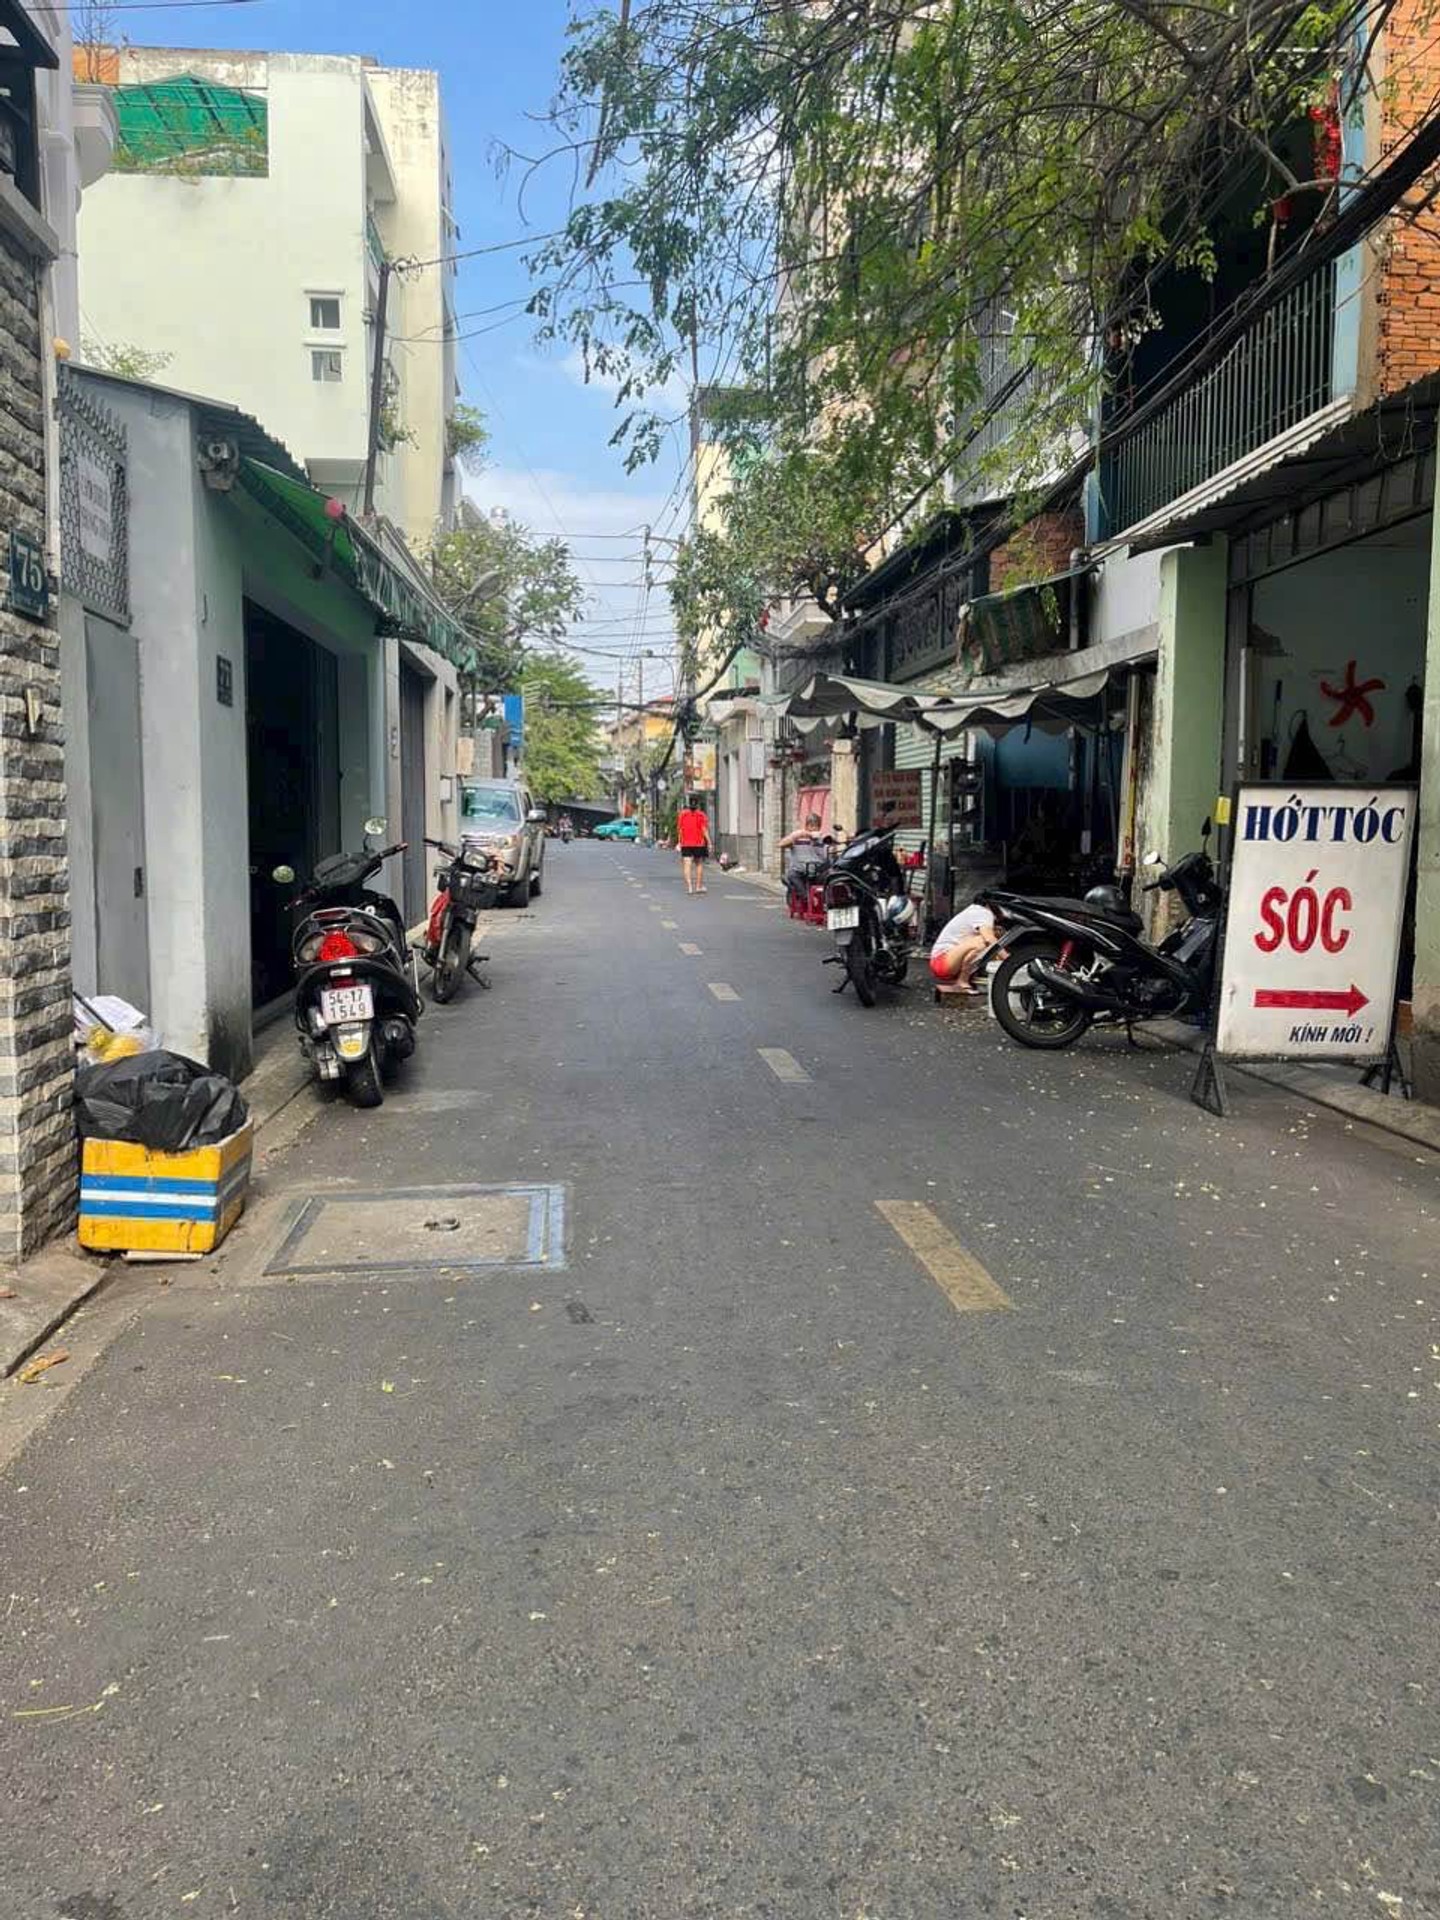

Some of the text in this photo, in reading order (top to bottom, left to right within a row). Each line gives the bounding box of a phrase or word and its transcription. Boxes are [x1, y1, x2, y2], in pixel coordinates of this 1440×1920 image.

[16, 545, 42, 592] 75
[1254, 869, 1353, 953] SÓC
[330, 1002, 366, 1019] 1549
[1289, 1021, 1328, 1043] KÍNH
